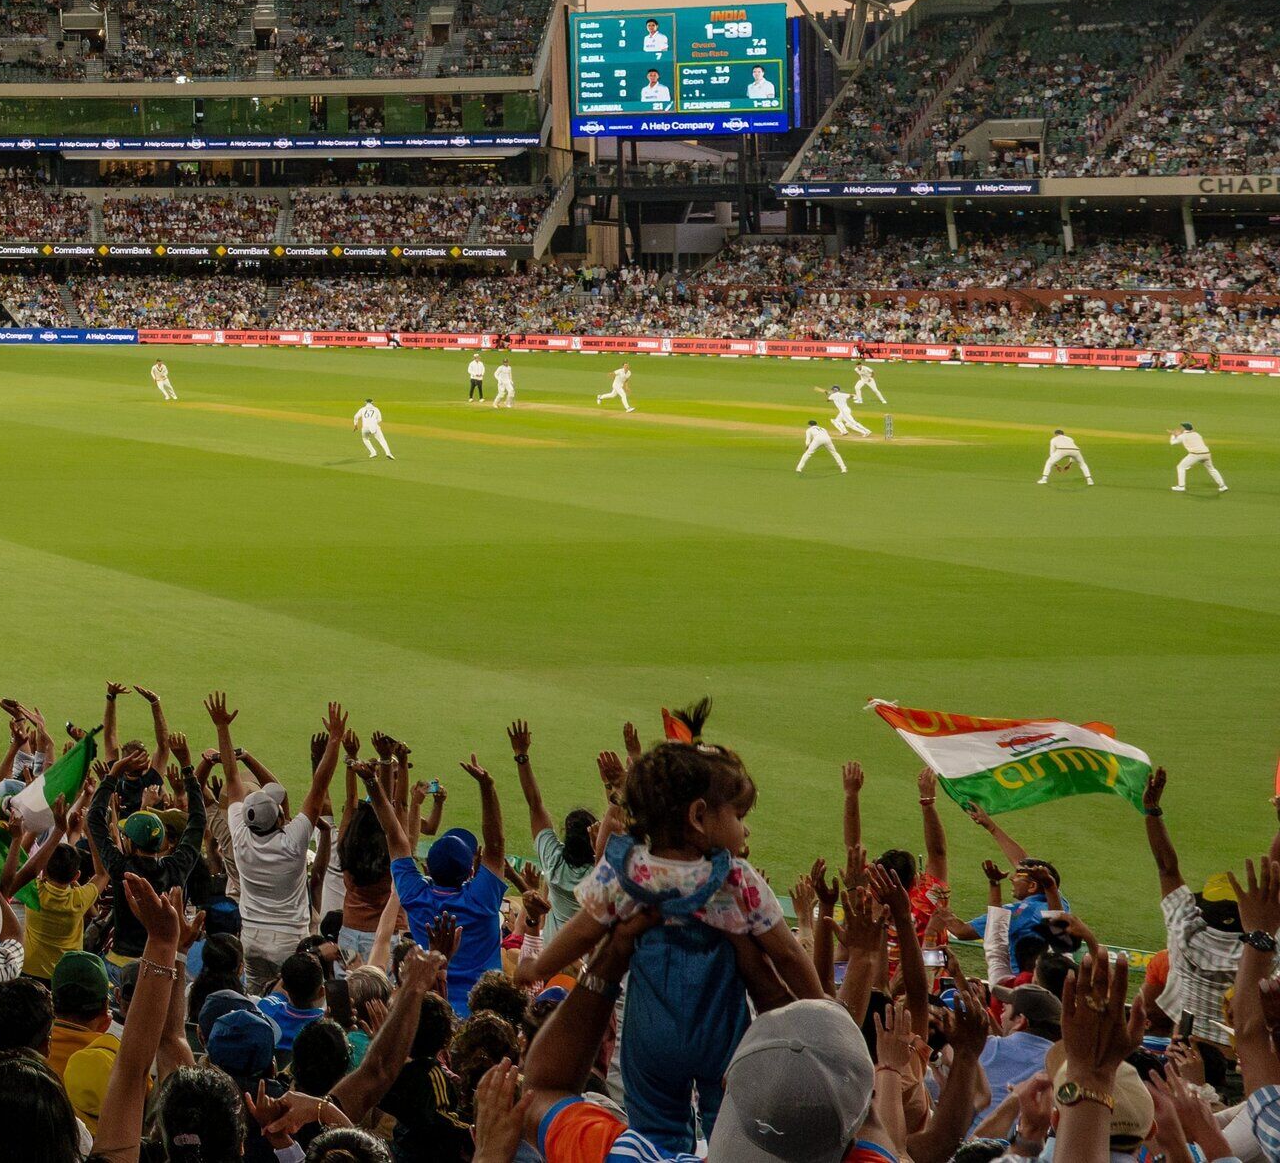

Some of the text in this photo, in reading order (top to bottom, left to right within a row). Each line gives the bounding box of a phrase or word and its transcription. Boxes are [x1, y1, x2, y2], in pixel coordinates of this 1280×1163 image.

[710, 10, 746, 22] INDIA
[705, 23, 752, 39] 1-39
[641, 122, 648, 130] A
[650, 122, 670, 132] Help
[672, 122, 714, 132] Company
[53, 246, 94, 254] CommBank
[227, 247, 269, 255] CommBank
[462, 248, 506, 256] CommBank
[364, 410, 374, 418] 67
[993, 747, 1120, 789] army
